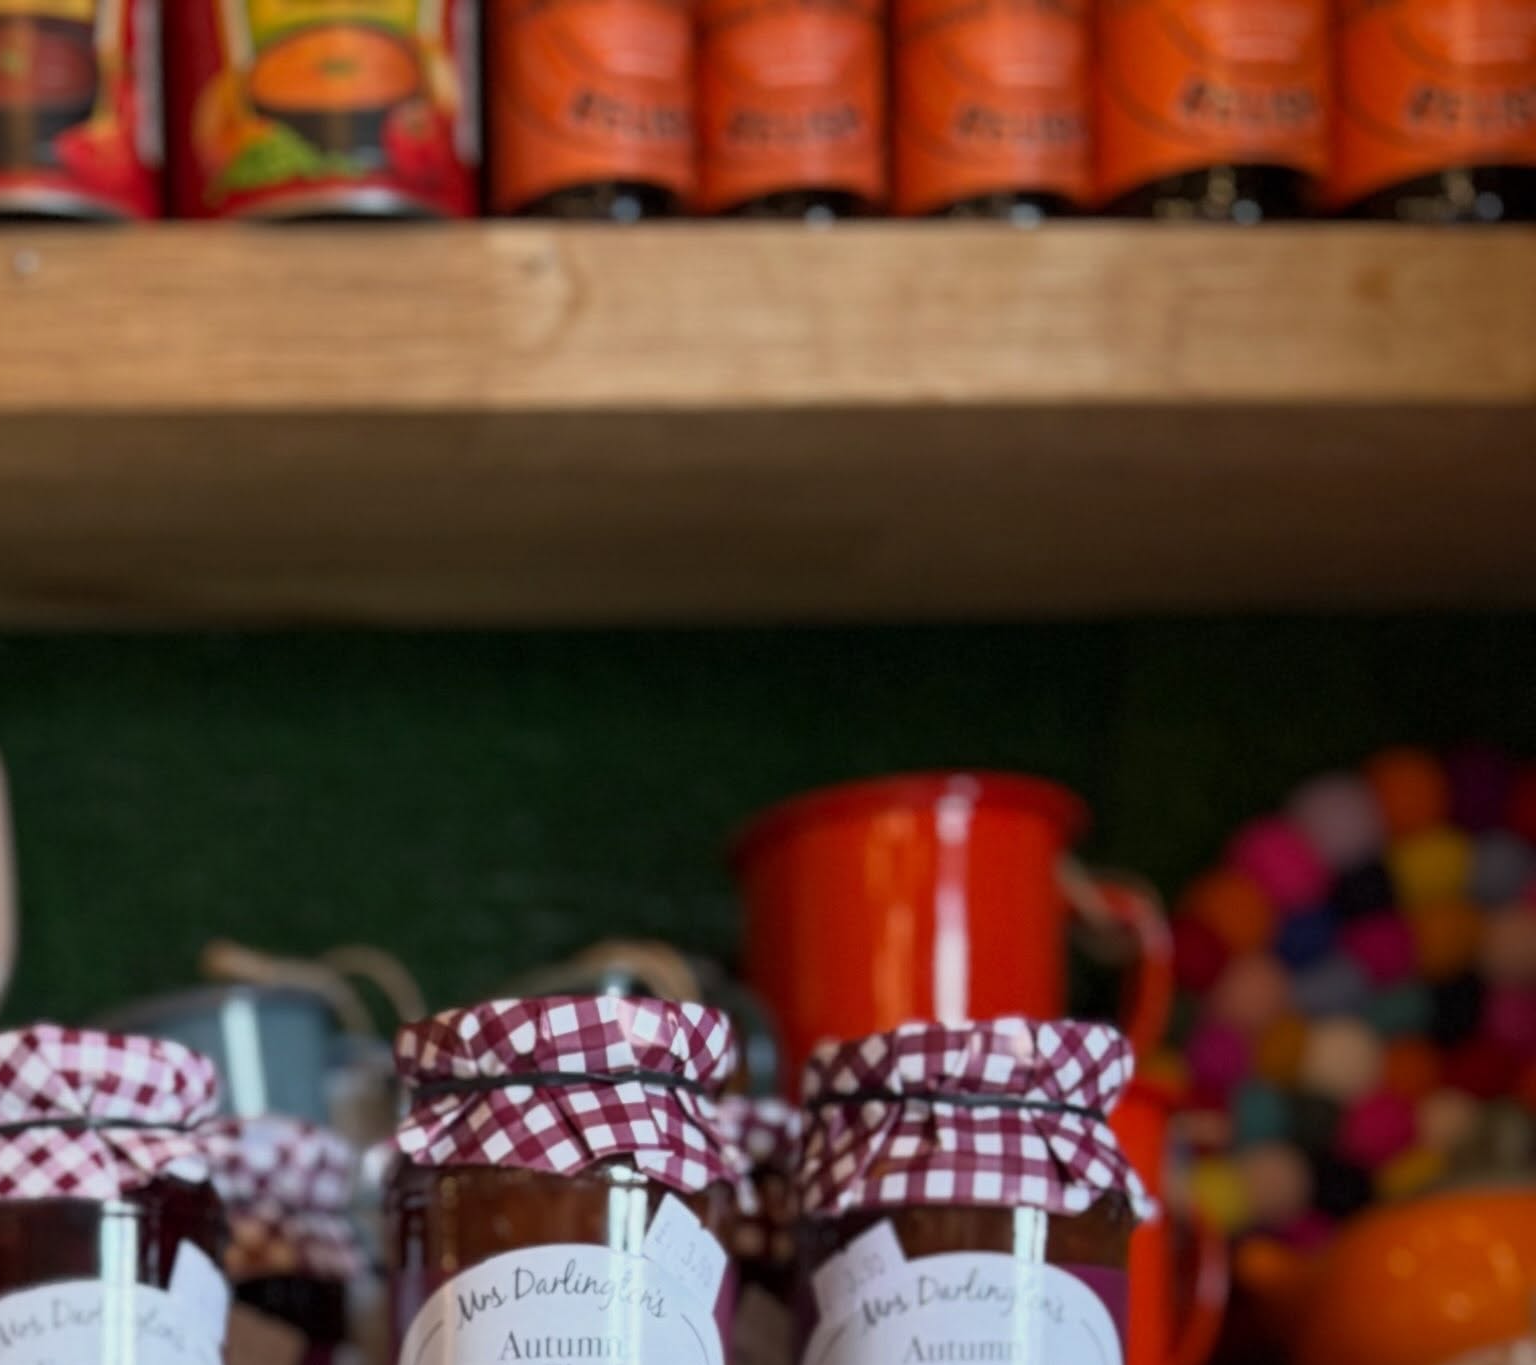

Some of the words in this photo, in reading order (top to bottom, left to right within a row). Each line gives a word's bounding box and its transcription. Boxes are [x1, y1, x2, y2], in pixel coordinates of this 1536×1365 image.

[457, 1286, 507, 1329] Mrs
[861, 1294, 909, 1334] Mrs
[497, 1331, 626, 1361] Autumn
